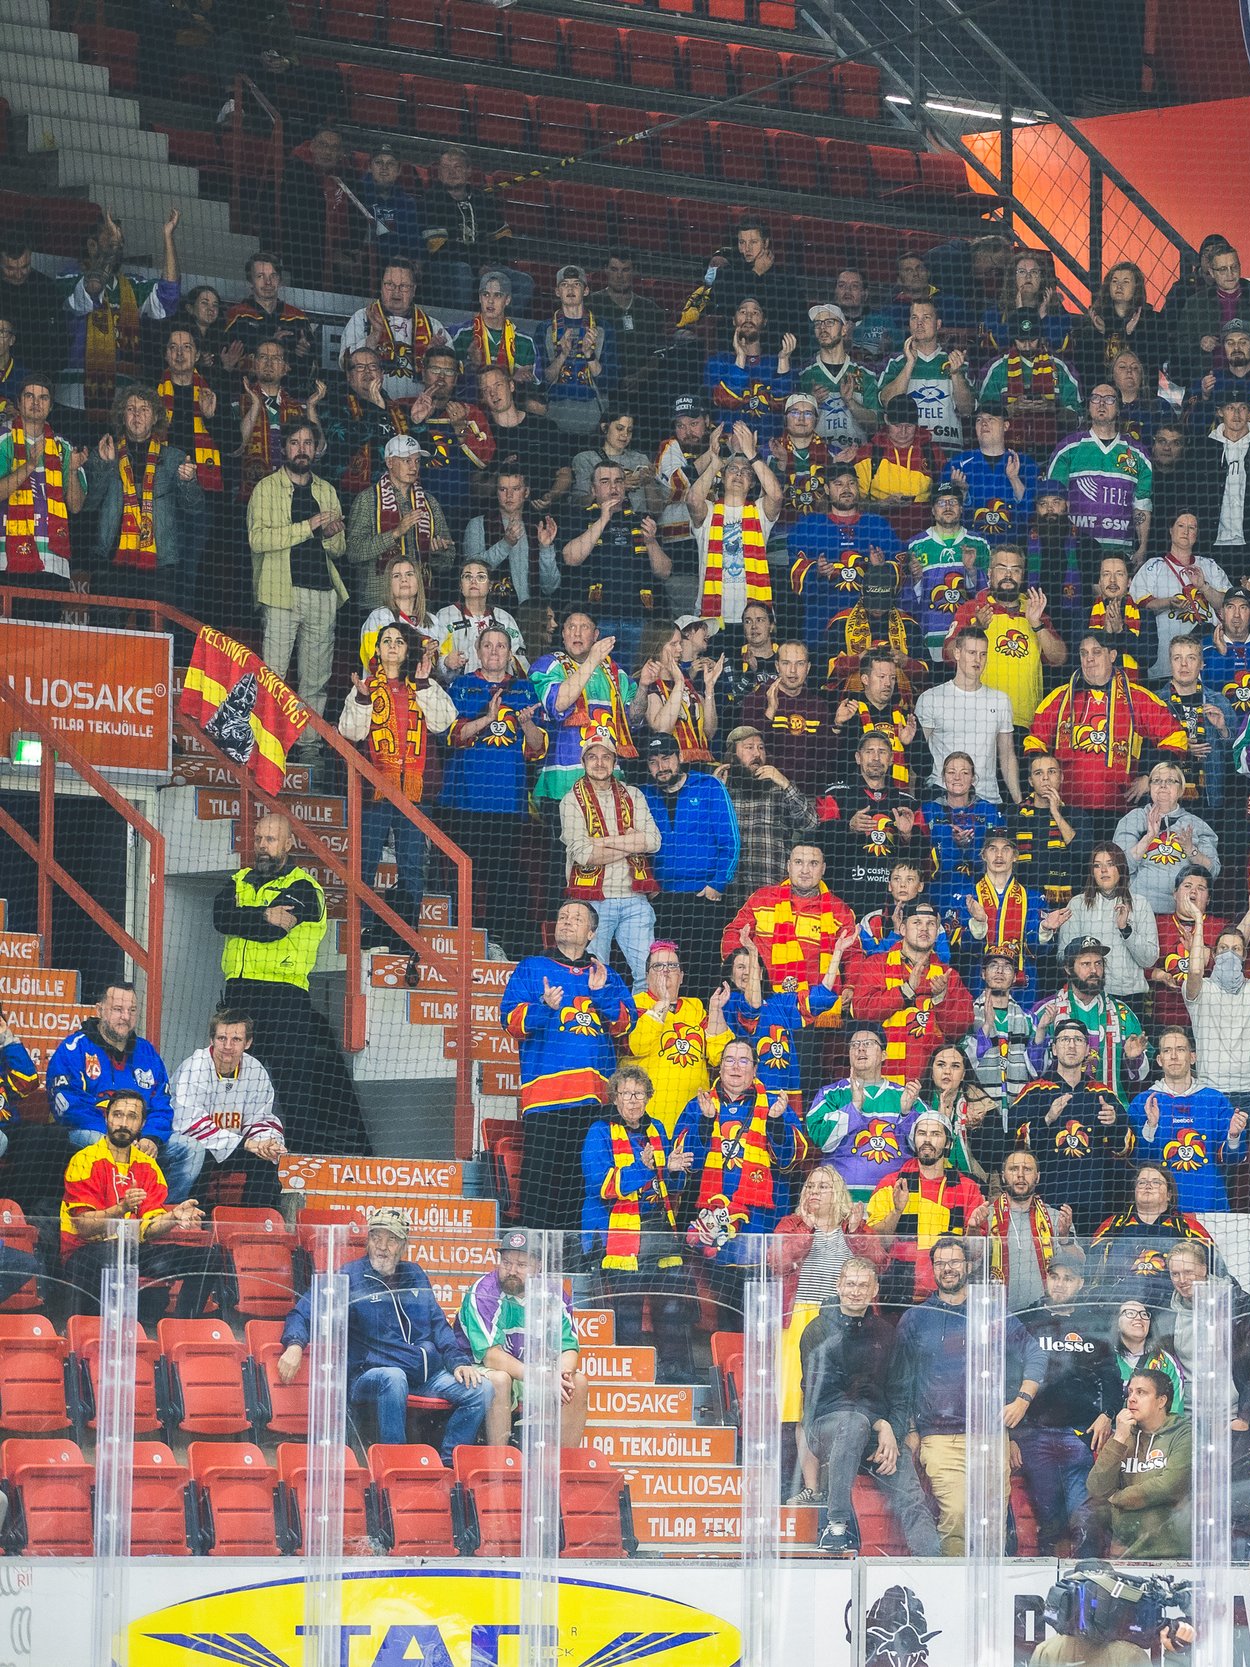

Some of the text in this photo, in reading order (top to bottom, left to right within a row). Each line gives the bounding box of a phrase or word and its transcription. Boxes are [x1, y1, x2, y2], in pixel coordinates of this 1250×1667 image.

[257, 666, 311, 728] SINCE 1967
[51, 717, 154, 738] TILAA TEKIJÖILLE
[209, 798, 240, 816] TILA
[619, 1433, 712, 1457] TEKIJÖILLE
[648, 1517, 696, 1537] TILAA
